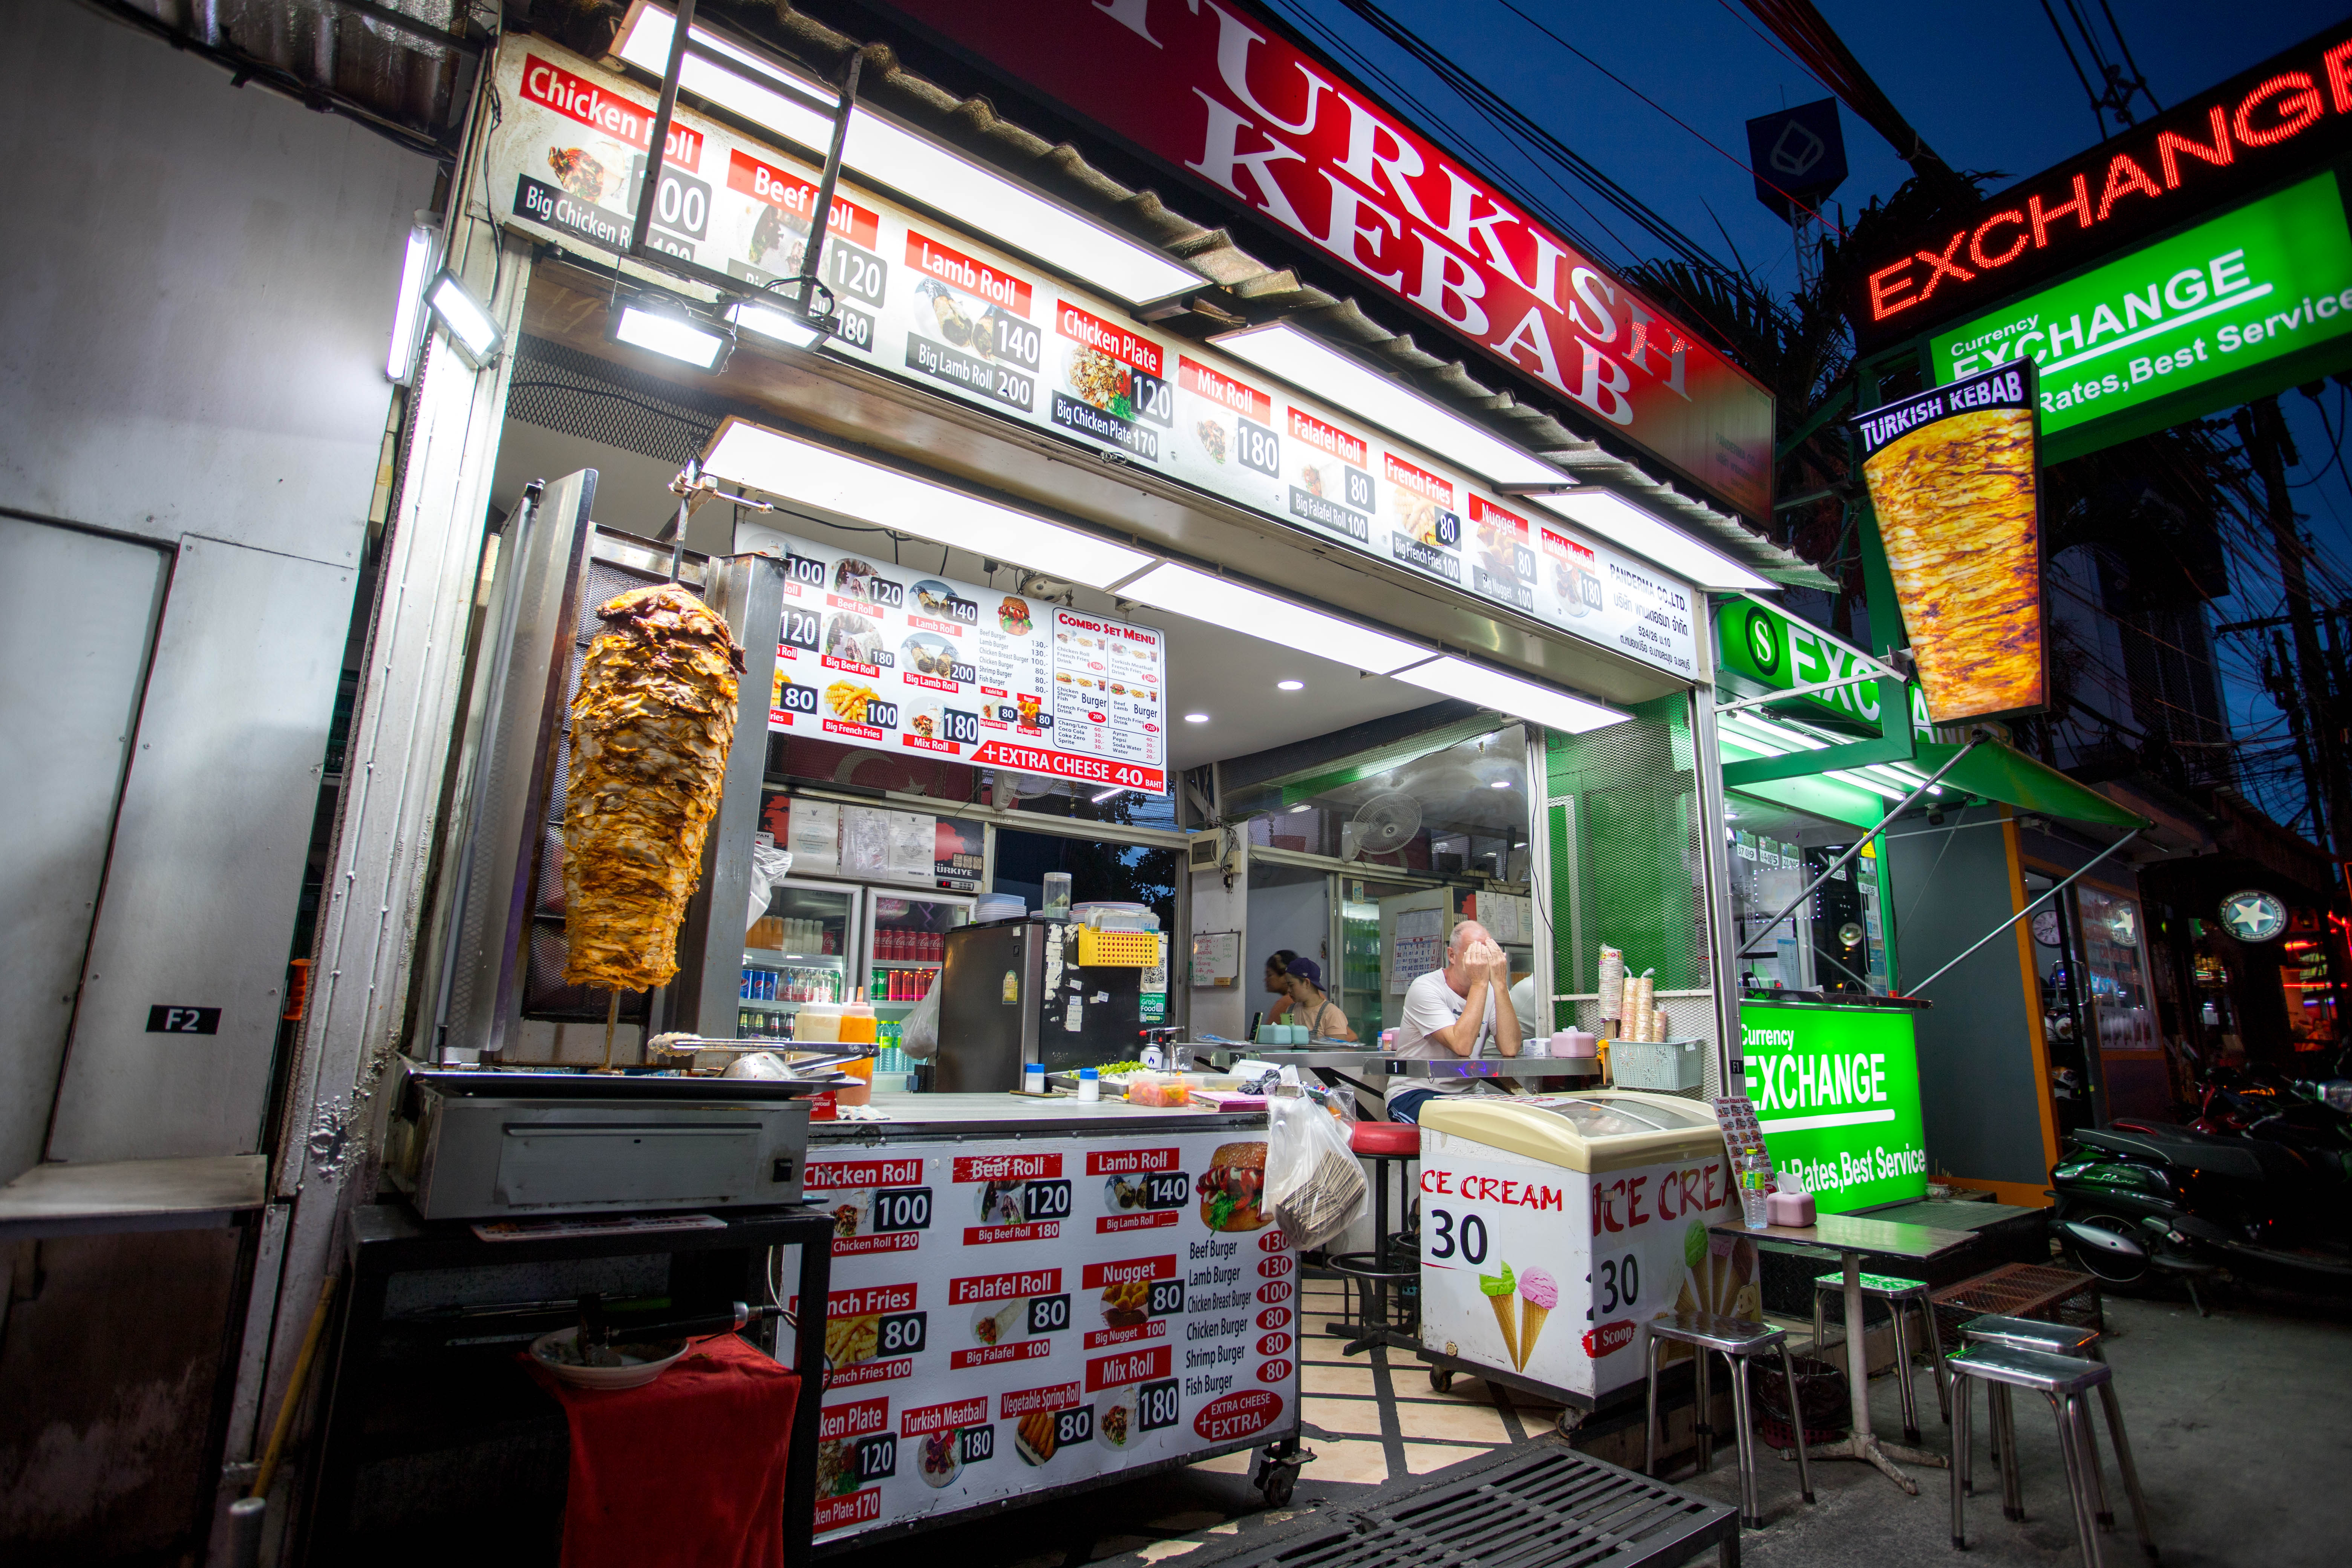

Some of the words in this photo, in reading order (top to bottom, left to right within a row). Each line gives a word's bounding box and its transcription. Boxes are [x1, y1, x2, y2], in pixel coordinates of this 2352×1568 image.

[528, 66, 638, 140] Chicken
[638, 169, 706, 232] 00
[754, 166, 809, 212] Beef
[526, 185, 553, 221] Big
[556, 200, 616, 242] Chicken
[1185, 86, 1633, 427] KEBAB
[837, 249, 881, 298] 120
[922, 242, 976, 289] Lamb
[980, 268, 1015, 307] Roll
[836, 309, 868, 345] 180
[1953, 249, 2251, 380] EXCHANGE
[2217, 288, 2352, 353] Service
[998, 320, 1038, 364] 140
[1063, 309, 1119, 356] Chicken
[1122, 337, 1156, 372] Plate
[1951, 314, 2039, 356] Currency
[919, 343, 937, 374] Big
[939, 353, 970, 381] Lamb
[972, 364, 992, 390] Roll
[997, 372, 1030, 406] 200
[1134, 376, 1169, 420] 120
[1198, 369, 1223, 401] Mix
[1227, 382, 1252, 414] Roll
[1057, 399, 1072, 426] Big
[1073, 406, 1108, 436] Chicken
[1110, 421, 1132, 445] Plate
[1133, 430, 1156, 456] 170
[1860, 397, 1943, 452] TURKISH
[1949, 371, 2023, 411] KEBAB
[1239, 427, 1277, 472] 180
[1294, 414, 1335, 452] Falafel
[1338, 436, 1360, 463] Roll
[1351, 475, 1367, 505] 80
[1387, 458, 1424, 493] French
[1426, 476, 1450, 505] Fries
[1439, 514, 1455, 543] 80
[1481, 503, 1516, 536] Nugget
[1395, 536, 1406, 558] Big
[1406, 542, 1426, 565] French
[1427, 551, 1442, 571] Fries
[1443, 559, 1459, 580] 100
[1518, 554, 1531, 577] 80
[1542, 532, 1566, 561] Turkish
[1567, 544, 1594, 571] Meatball
[791, 558, 823, 585] 100
[1610, 564, 1654, 597] PANDERMA
[872, 581, 902, 605] 120
[1492, 578, 1512, 600] Nugget
[1518, 587, 1532, 610] 100
[1583, 579, 1600, 606] 180
[951, 602, 975, 621] 140
[1638, 626, 1657, 642] 524/26
[826, 657, 840, 670] Big
[842, 660, 861, 673] Beef
[863, 665, 876, 675] Roll
[873, 651, 892, 665] 180
[980, 647, 997, 656] Chicken
[1014, 654, 1028, 663] Burger
[979, 666, 995, 675] Shrimp
[997, 669, 1012, 678] Burger
[990, 677, 1005, 686] Burger
[1082, 693, 1107, 708] Burger
[1134, 704, 1157, 718] Burger
[826, 721, 838, 733] Big
[839, 724, 862, 735] French
[864, 727, 880, 738] Fries
[1058, 720, 1087, 729] Chang/Leo
[1054, 756, 1110, 780] CHEESE
[1115, 767, 1143, 786] 40
[1145, 779, 1162, 789] BAHT
[1743, 835, 1753, 845] EUR
[1766, 841, 1776, 851] GBP
[1787, 848, 1798, 857] AUD
[165, 1008, 201, 1031] F2
[1741, 1024, 1794, 1050] Currency
[1393, 1061, 1398, 1072] 1
[1732, 1061, 1740, 1072] F1
[1744, 1053, 1887, 1112] EXCHANGE
[804, 1166, 877, 1186] Chicken
[882, 1162, 917, 1182] Roll
[1876, 1143, 1926, 1179] Service
[1461, 1174, 1563, 1212] CREAM
[1592, 1175, 1650, 1237] ICE
[1658, 1163, 1738, 1221] CREA
[879, 1195, 927, 1226] 100
[834, 1237, 871, 1252] Chicken
[874, 1236, 891, 1249] Roll
[894, 1234, 918, 1248] 120
[1190, 1240, 1208, 1259] Beef
[1210, 1241, 1237, 1261] Burger
[1431, 1208, 1488, 1265] 30
[1103, 1262, 1156, 1285] Nugget
[1263, 1257, 1289, 1276] 130
[1601, 1253, 1639, 1315] 30
[1603, 1325, 1632, 1348] Scoop
[823, 1370, 858, 1385] Fench
[860, 1366, 884, 1380] Fries
[886, 1360, 911, 1377] 100
[1102, 1360, 1126, 1384] Mix
[1130, 1352, 1154, 1378] Roll
[905, 1412, 941, 1434] Turkish
[943, 1400, 985, 1427] Meatball
[1141, 1386, 1178, 1426] 180
[1211, 1399, 1238, 1416] EXTRA
[1240, 1393, 1271, 1410] CHEESE
[1211, 1412, 1262, 1438] EXTRA
